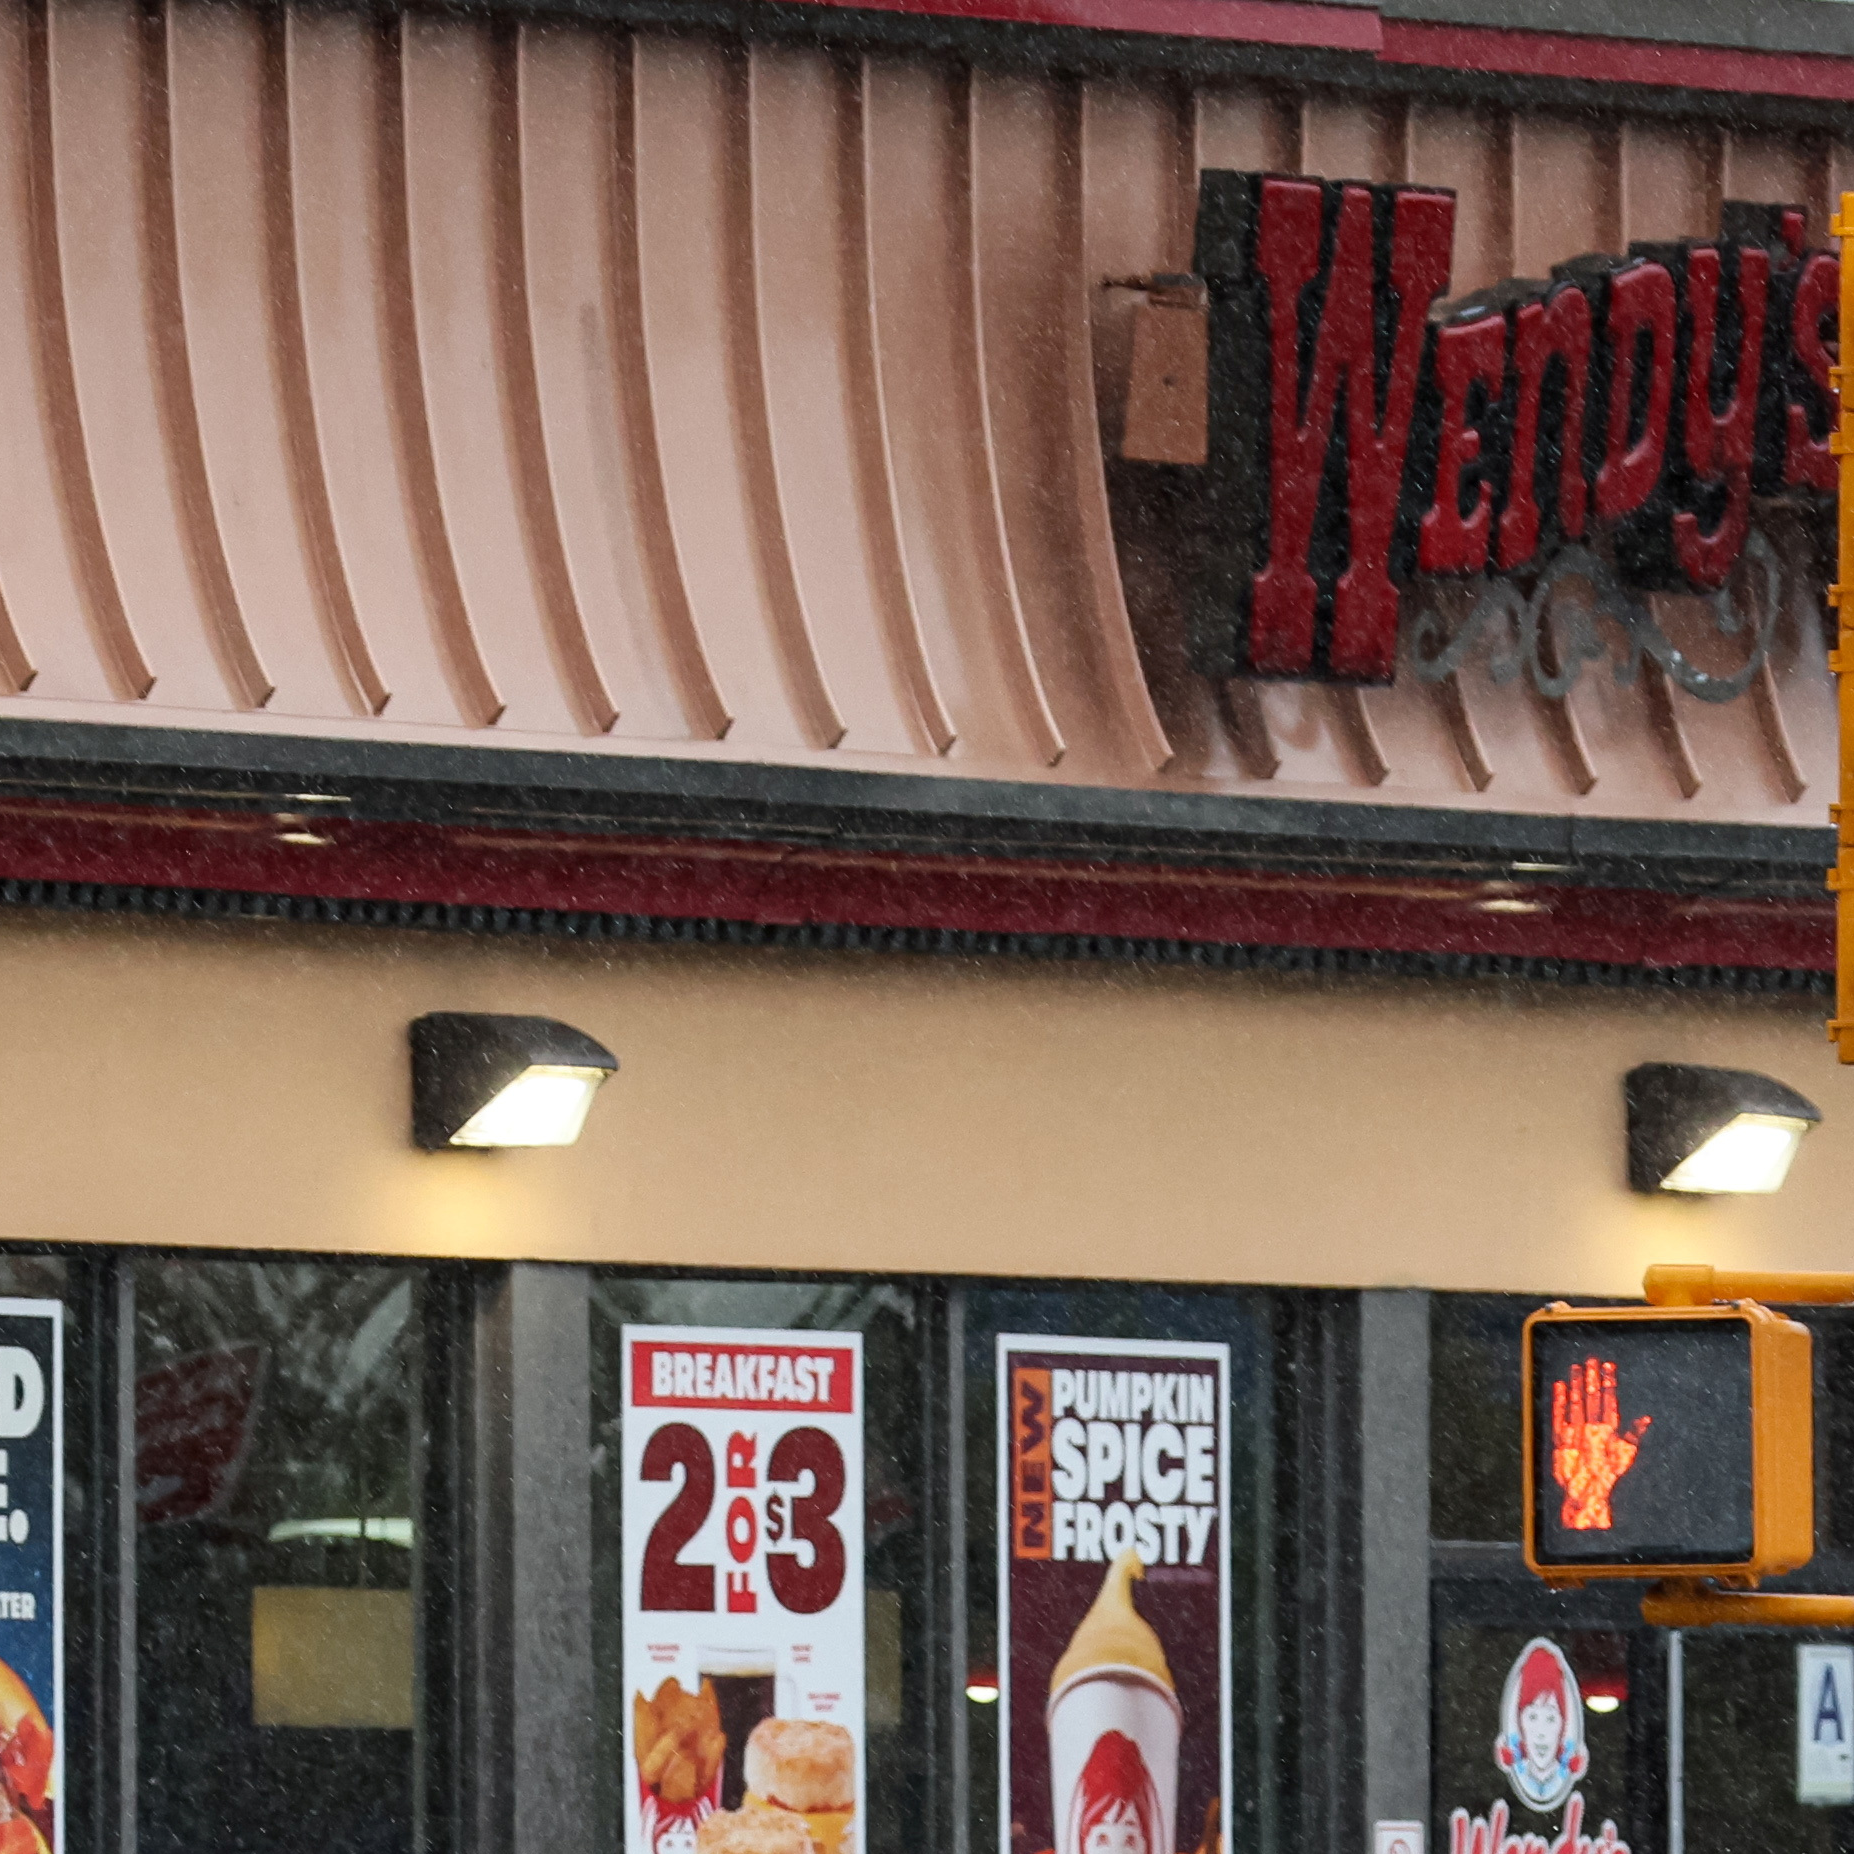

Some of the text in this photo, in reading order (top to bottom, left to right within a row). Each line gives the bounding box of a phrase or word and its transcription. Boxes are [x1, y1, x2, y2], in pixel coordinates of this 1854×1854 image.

[651, 1351, 835, 1404] BREAKFAST
[1051, 1368, 1215, 1424] PUMPKIN
[1020, 1380, 1046, 1549] NEW
[1051, 1417, 1215, 1504] SPICE
[640, 1422, 715, 1611] 2
[725, 1430, 757, 1613] FOR
[1051, 1500, 1218, 1566] FROSTY
[1813, 1661, 1845, 1742] A
